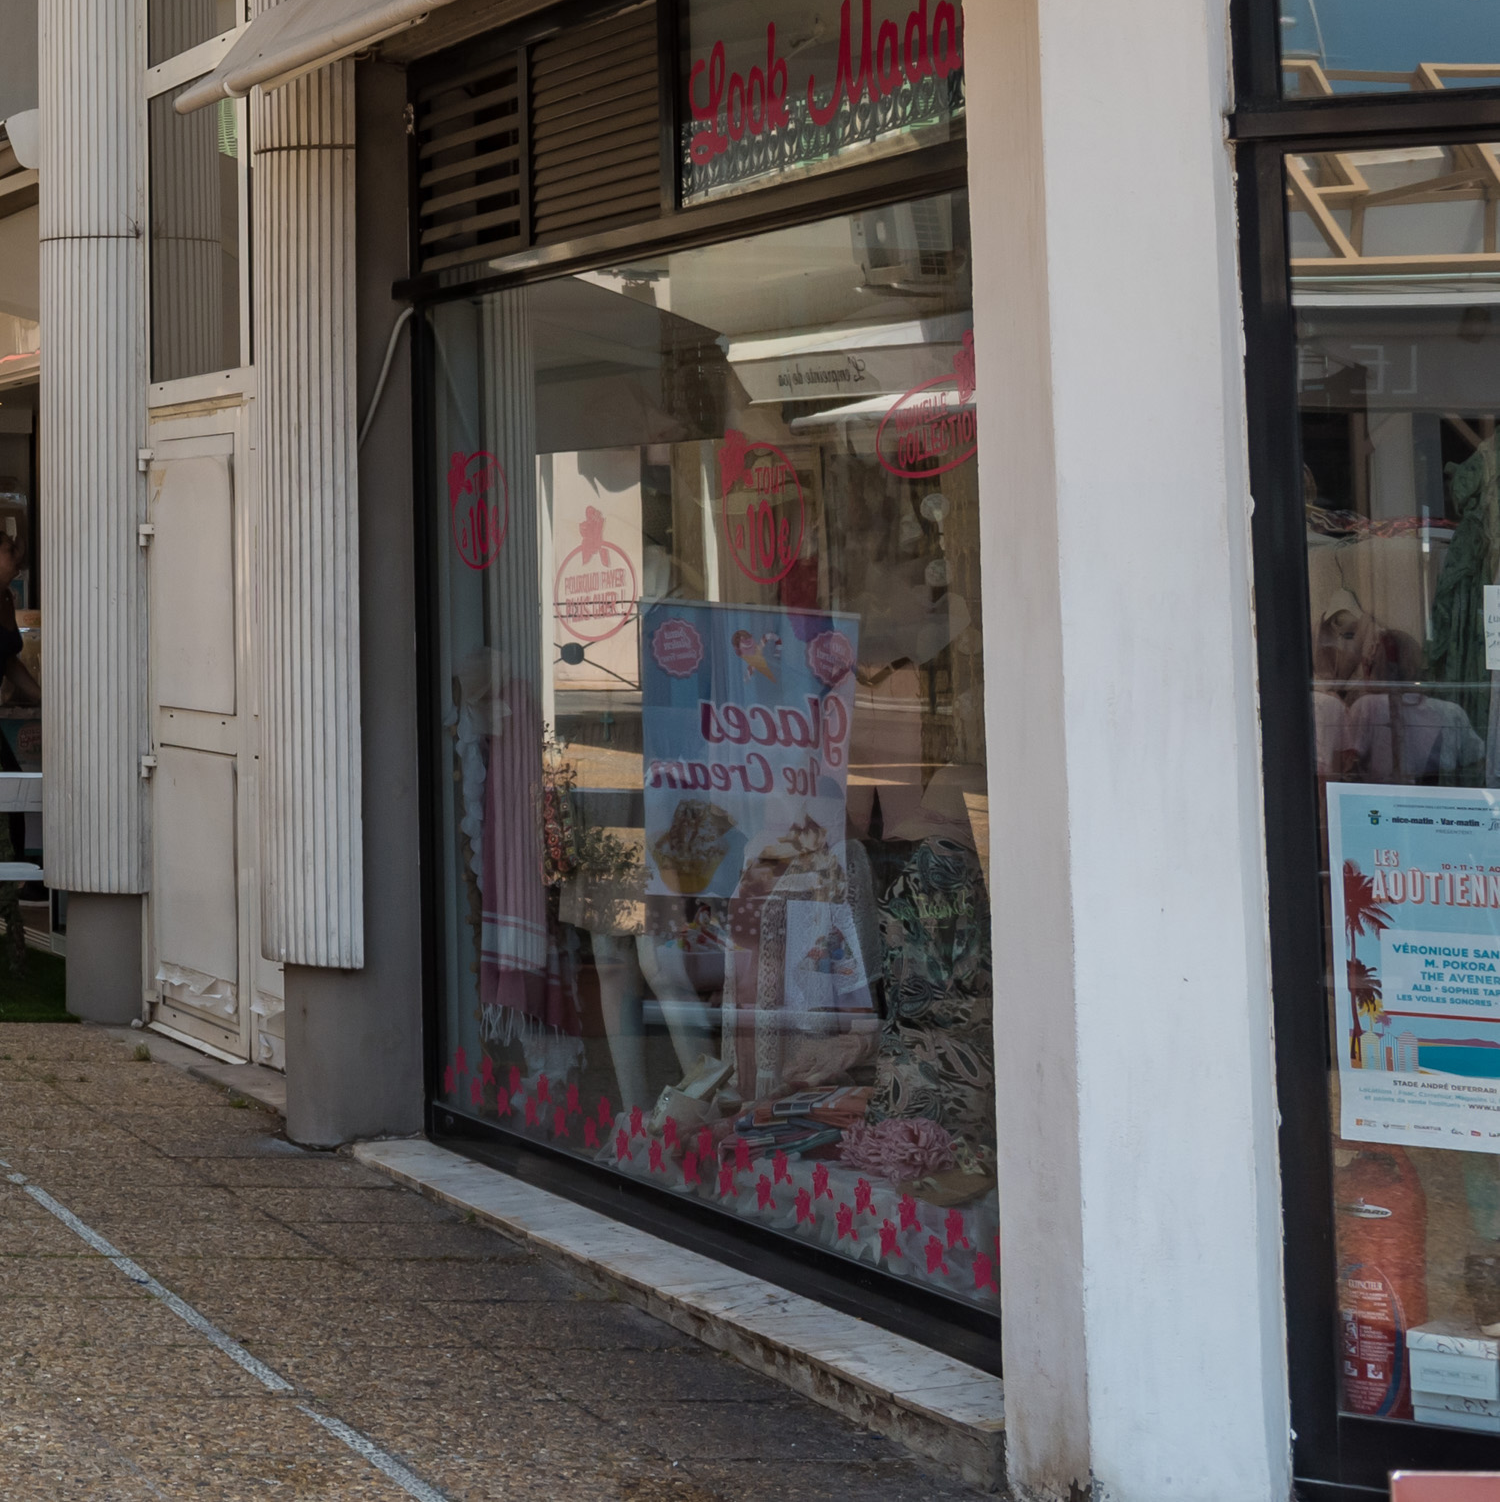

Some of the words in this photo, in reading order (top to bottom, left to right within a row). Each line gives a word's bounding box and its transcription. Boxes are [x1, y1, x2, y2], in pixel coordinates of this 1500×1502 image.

[689, 39, 789, 166] Look
[895, 392, 948, 434] NOUVELLE
[755, 464, 788, 495] TOUT
[565, 572, 599, 595] POURQUOI
[601, 568, 625, 589] PAYER
[1392, 817, 1434, 825] nice-matin
[1440, 818, 1480, 827] Var-matin
[1374, 849, 1399, 867] LES
[1392, 942, 1469, 958] VÉRONIQUE
[1473, 949, 1500, 959] SAN
[1424, 959, 1439, 968] M.
[1443, 960, 1496, 972] POKORA
[1420, 971, 1445, 982] THE
[1412, 984, 1431, 992] ALB
[1441, 986, 1479, 995] SOPHIE
[1396, 994, 1413, 1002] LES
[1416, 995, 1447, 1004] VOILES
[1449, 997, 1492, 1007] SONORES
[1393, 1079, 1419, 1088] STADE
[1420, 1081, 1449, 1091] ANDRÉ
[1451, 1084, 1498, 1094] DEFERRARI
